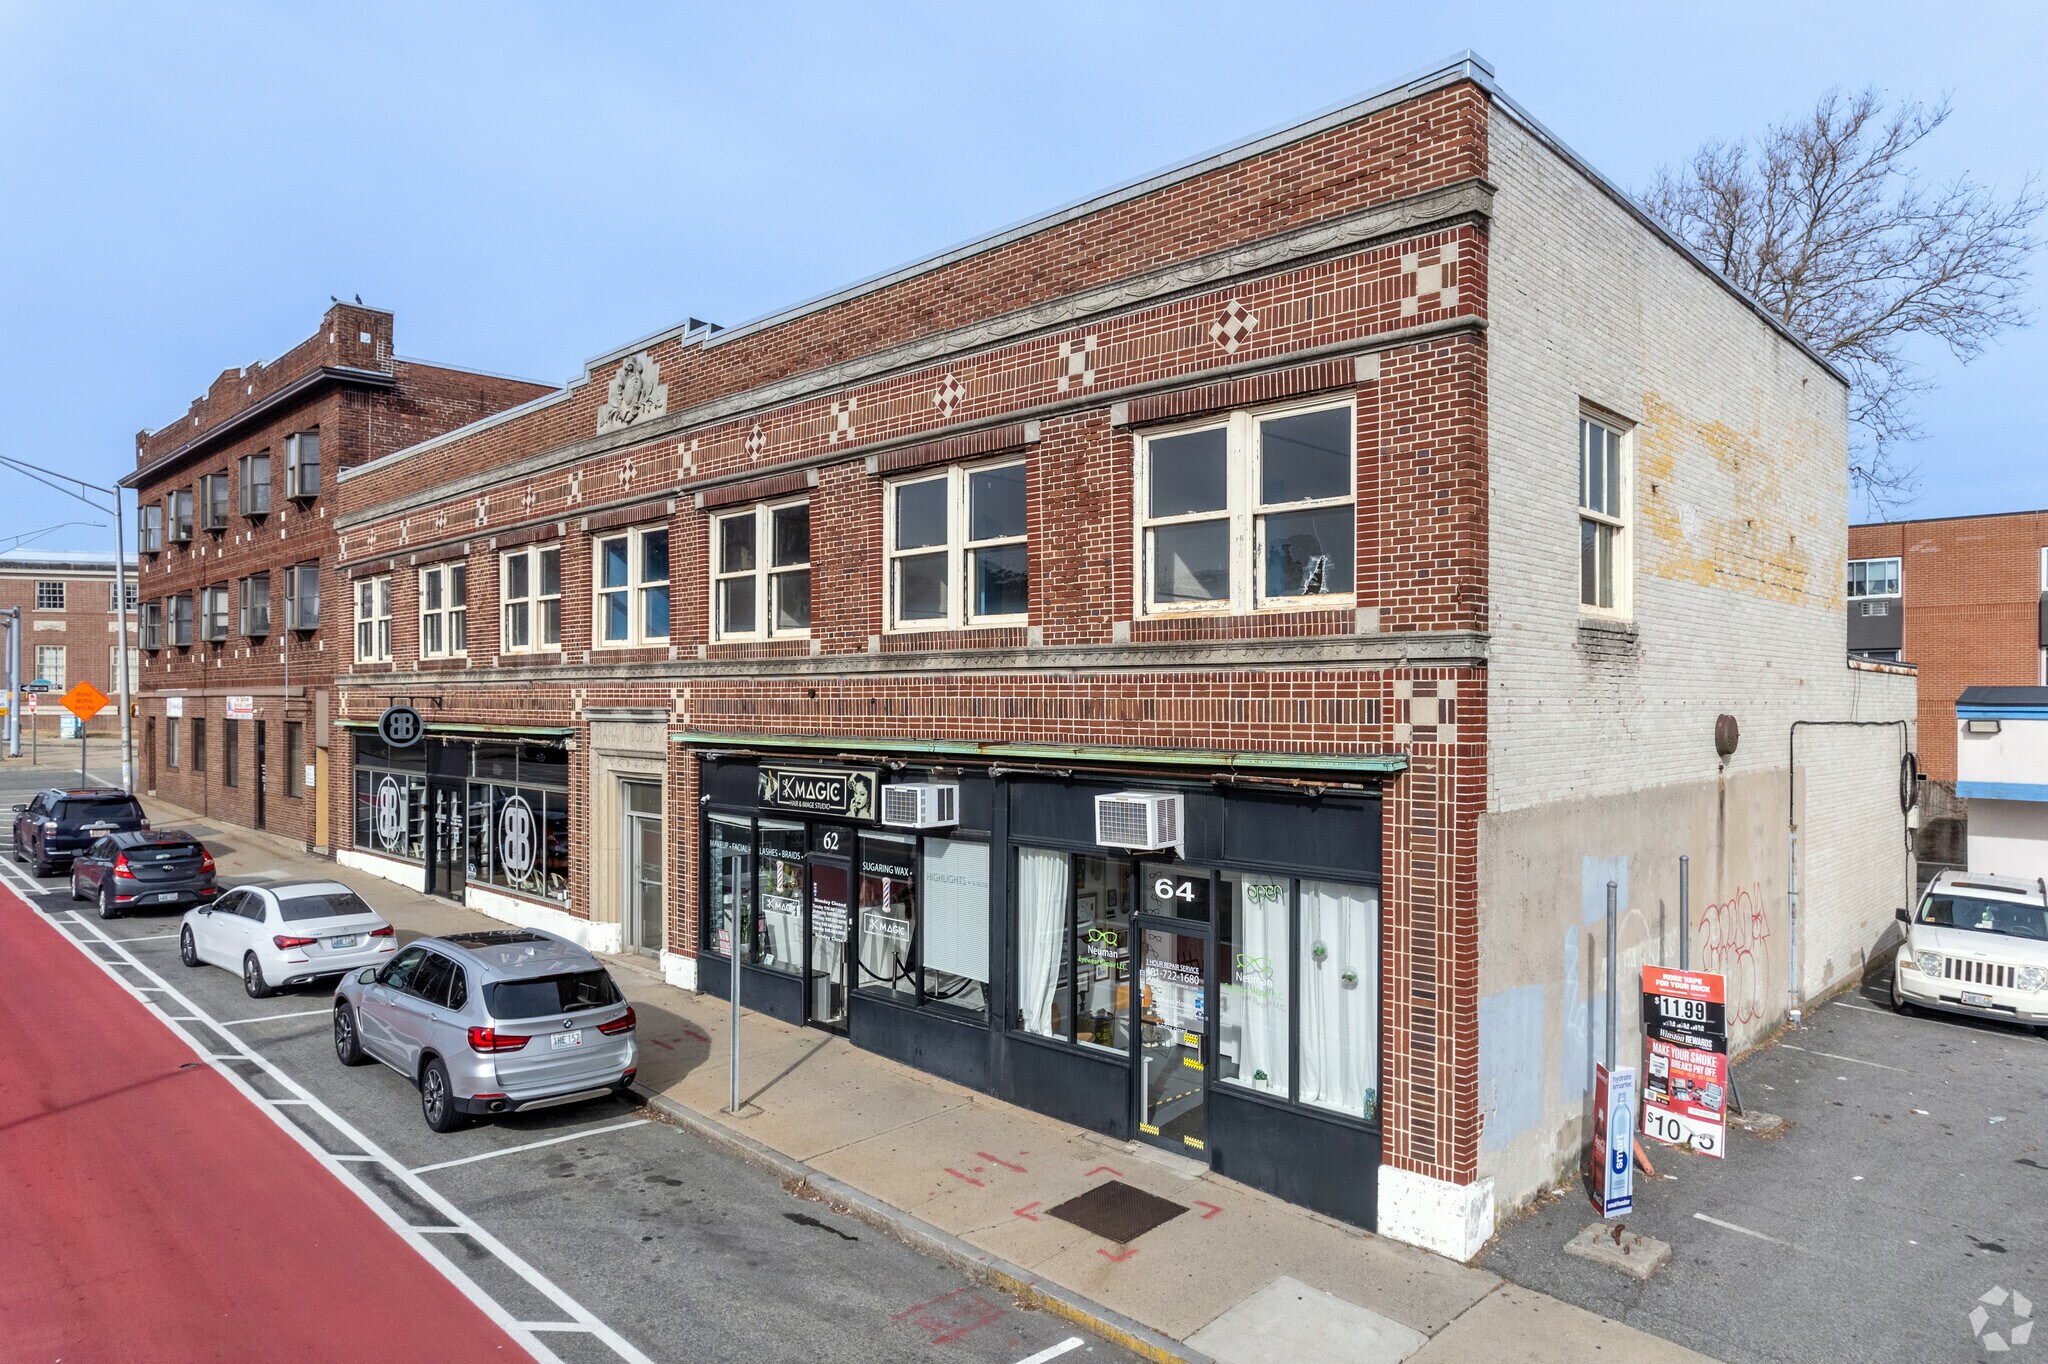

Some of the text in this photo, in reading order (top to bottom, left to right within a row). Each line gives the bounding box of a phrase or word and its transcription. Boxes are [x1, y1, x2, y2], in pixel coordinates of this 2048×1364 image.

[802, 801, 814, 809] IMAGE
[823, 832, 839, 851] 62
[709, 840, 801, 860] MAKEUP FACIAL LASHES BRAIDS
[862, 861, 909, 876] SUGARING WAX
[926, 872, 966, 885] HIGHLIGHTS
[1154, 878, 1195, 902] 64
[814, 897, 830, 905] Monday
[1088, 945, 1118, 959] Neuman
[1078, 955, 1100, 965] Eyewear
[1164, 961, 1179, 970] REPAIR
[1180, 964, 1199, 974] SERVICE
[1236, 972, 1273, 987] Neuman
[1655, 979, 1669, 987] FOR
[1670, 981, 1690, 990] YOUR
[1690, 984, 1711, 993] BUCK
[1662, 973, 1703, 985] MORE VAPE
[1659, 1028, 1685, 1043] Winston
[1685, 1035, 1713, 1048] REWARDS
[1652, 1042, 1717, 1068] MAKE YOUR SMOKE
[1670, 1059, 1692, 1072] BREAKS
[1693, 1065, 1705, 1075] PAY
[1612, 1074, 1632, 1084] hydrate
[1616, 1133, 1624, 1170] smart
[1607, 1199, 1631, 1210] smartwater
